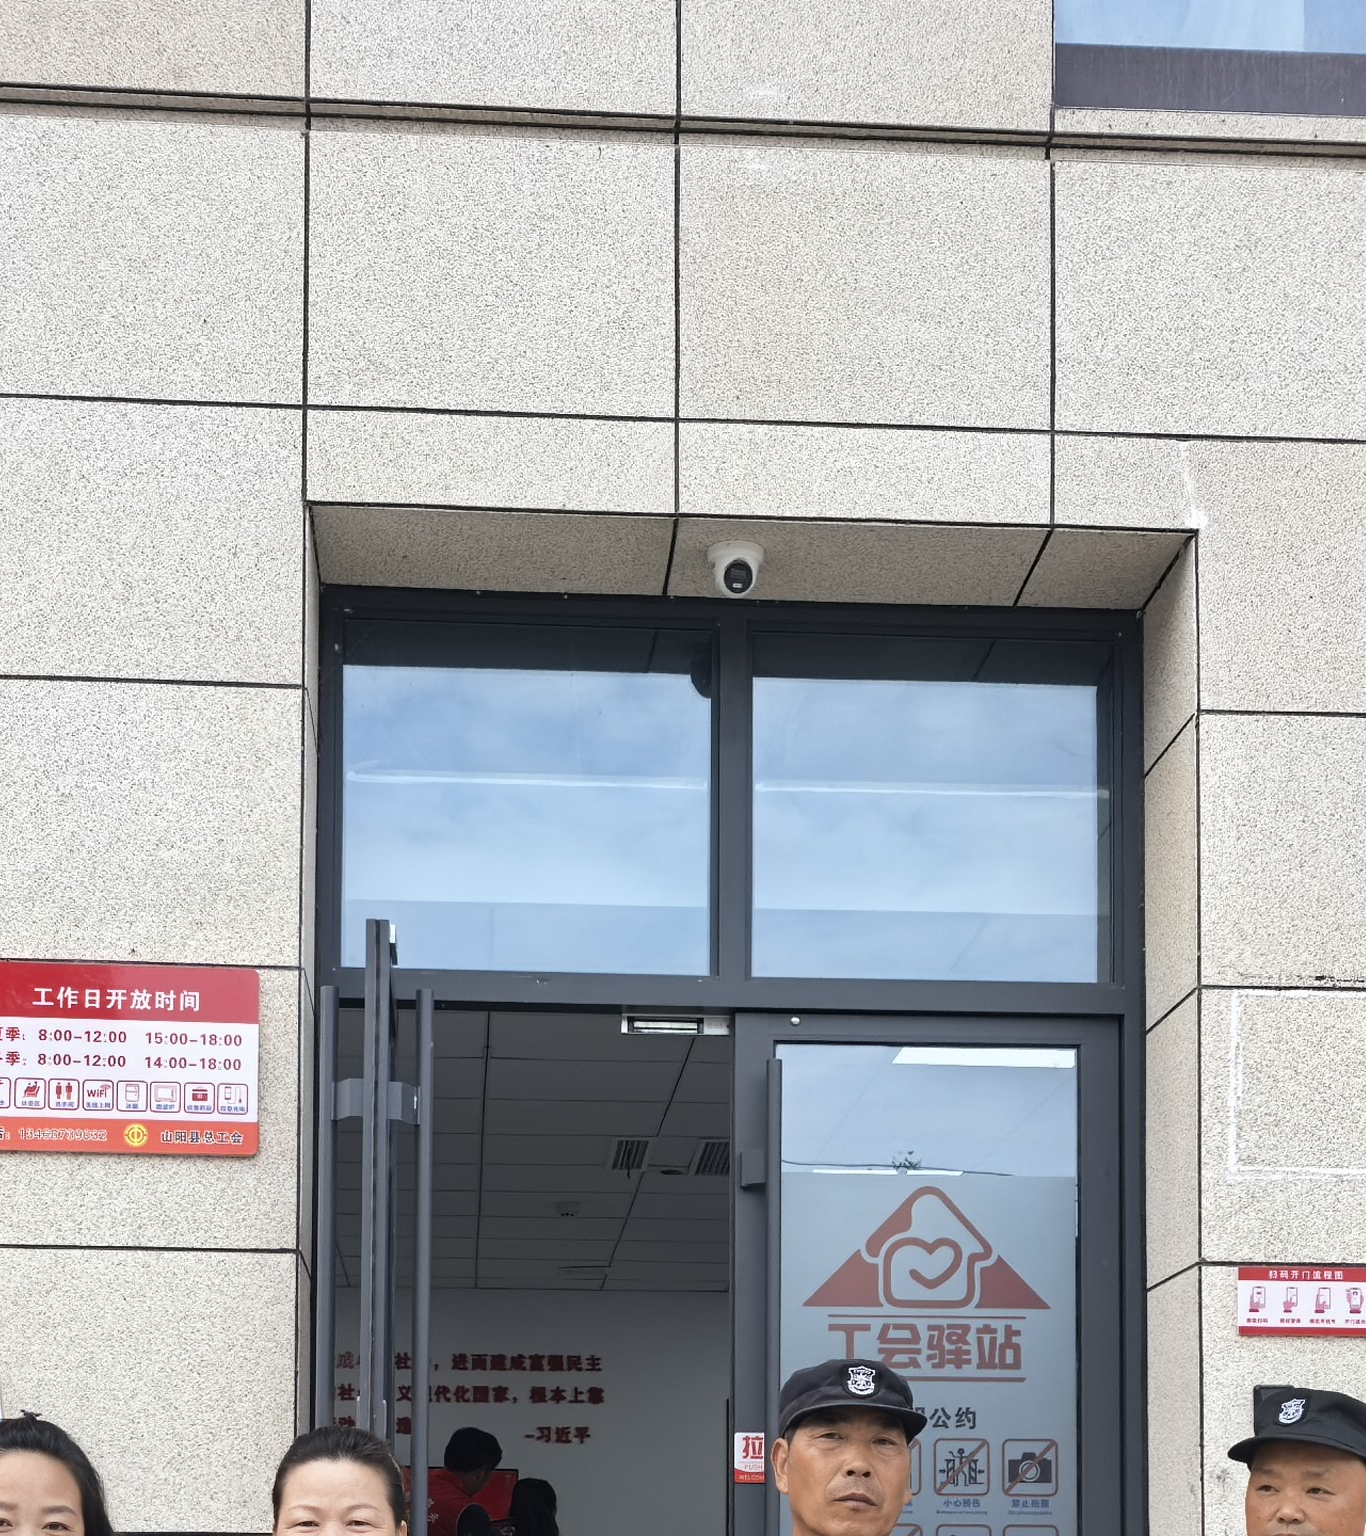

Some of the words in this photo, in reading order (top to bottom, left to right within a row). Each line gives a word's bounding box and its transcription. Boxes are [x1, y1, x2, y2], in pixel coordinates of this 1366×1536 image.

[32, 987, 200, 1011] 工作日开放时间
[161, 1130, 243, 1145] 山阳县总工会
[1268, 1270, 1344, 1280] 扫码开门流程图
[828, 1323, 1023, 1371] 工会驿站
[914, 1406, 977, 1430] 公约
[742, 1435, 764, 1460] 拉
